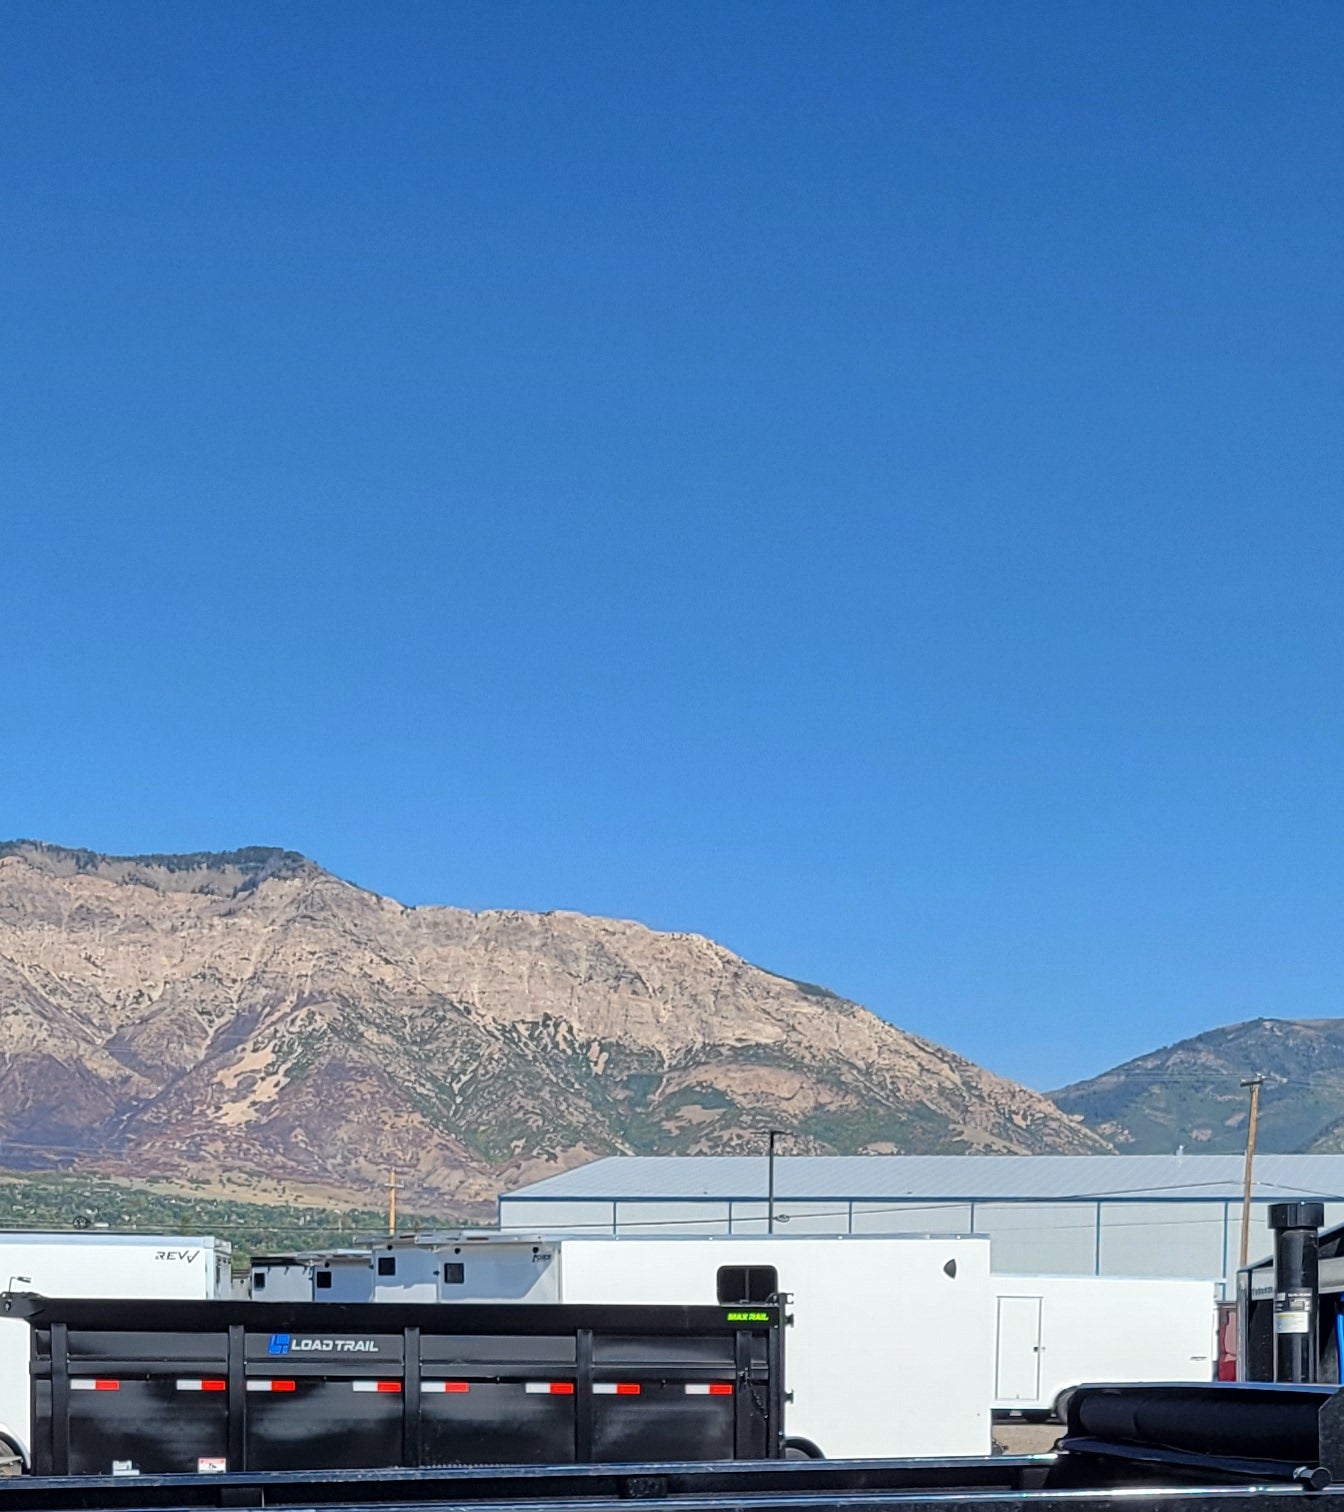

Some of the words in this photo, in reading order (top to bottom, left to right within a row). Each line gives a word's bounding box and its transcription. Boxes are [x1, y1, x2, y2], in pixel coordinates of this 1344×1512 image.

[727, 1312, 748, 1321] MAX
[748, 1312, 769, 1321] RAIL
[291, 1339, 333, 1351] LOAD
[334, 1340, 379, 1352] TRAIL
